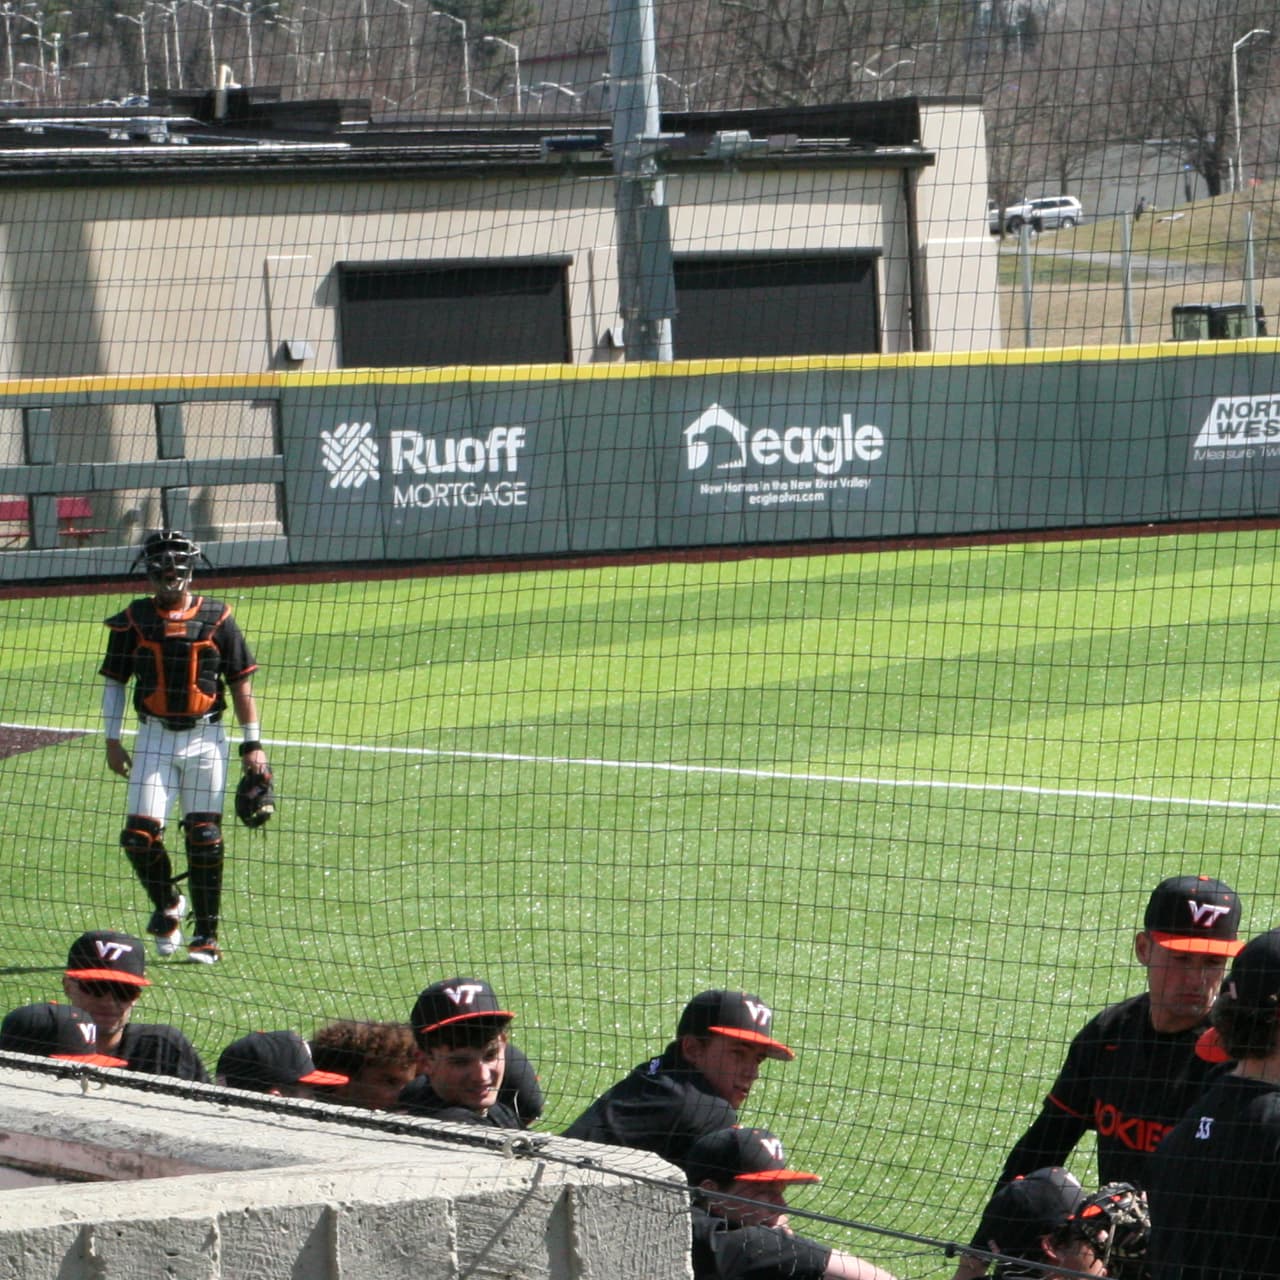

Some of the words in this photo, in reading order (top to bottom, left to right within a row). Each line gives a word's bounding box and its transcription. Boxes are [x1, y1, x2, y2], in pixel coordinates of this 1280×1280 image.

[391, 426, 527, 475] Ruoff
[751, 412, 885, 475] eagle
[1193, 449, 1256, 461] Measure
[393, 481, 528, 509] MORTGAGE
[699, 483, 723, 495] New
[724, 481, 759, 495] Homes
[759, 480, 770, 492] in
[771, 479, 789, 491] the
[789, 478, 812, 491] New
[814, 477, 838, 490] River
[839, 476, 872, 490] Valley
[1189, 900, 1231, 928] VT
[95, 939, 133, 961] VT
[443, 983, 483, 1005] VT
[744, 1000, 772, 1026] VT
[1094, 1099, 1175, 1153] OKIE
